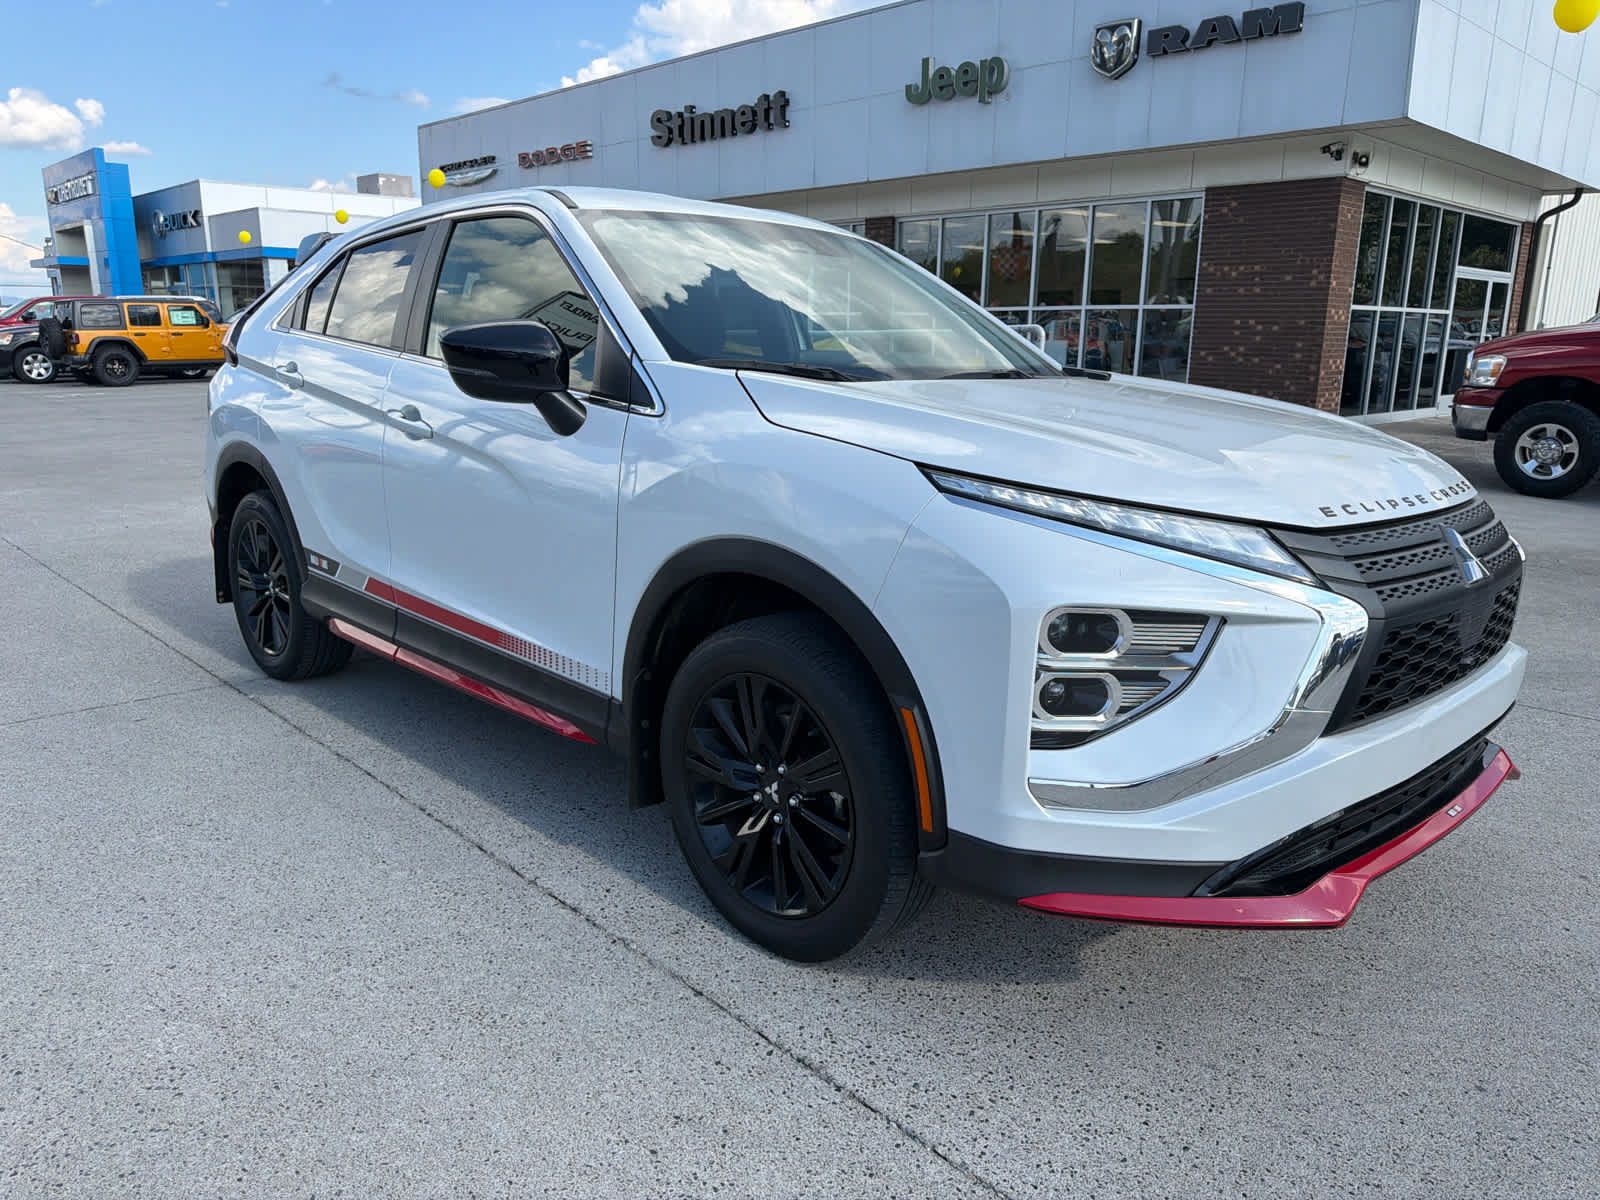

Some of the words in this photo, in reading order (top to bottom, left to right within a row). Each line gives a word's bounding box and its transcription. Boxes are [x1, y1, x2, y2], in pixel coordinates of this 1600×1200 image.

[1146, 1, 1306, 57] RAM
[905, 55, 1009, 105] Jeep
[650, 90, 790, 147] Stinnett
[518, 140, 592, 168] DODGE
[163, 208, 200, 230] BUICK
[1318, 493, 1428, 518] ECLIPSE
[1429, 478, 1472, 501] CROSS
